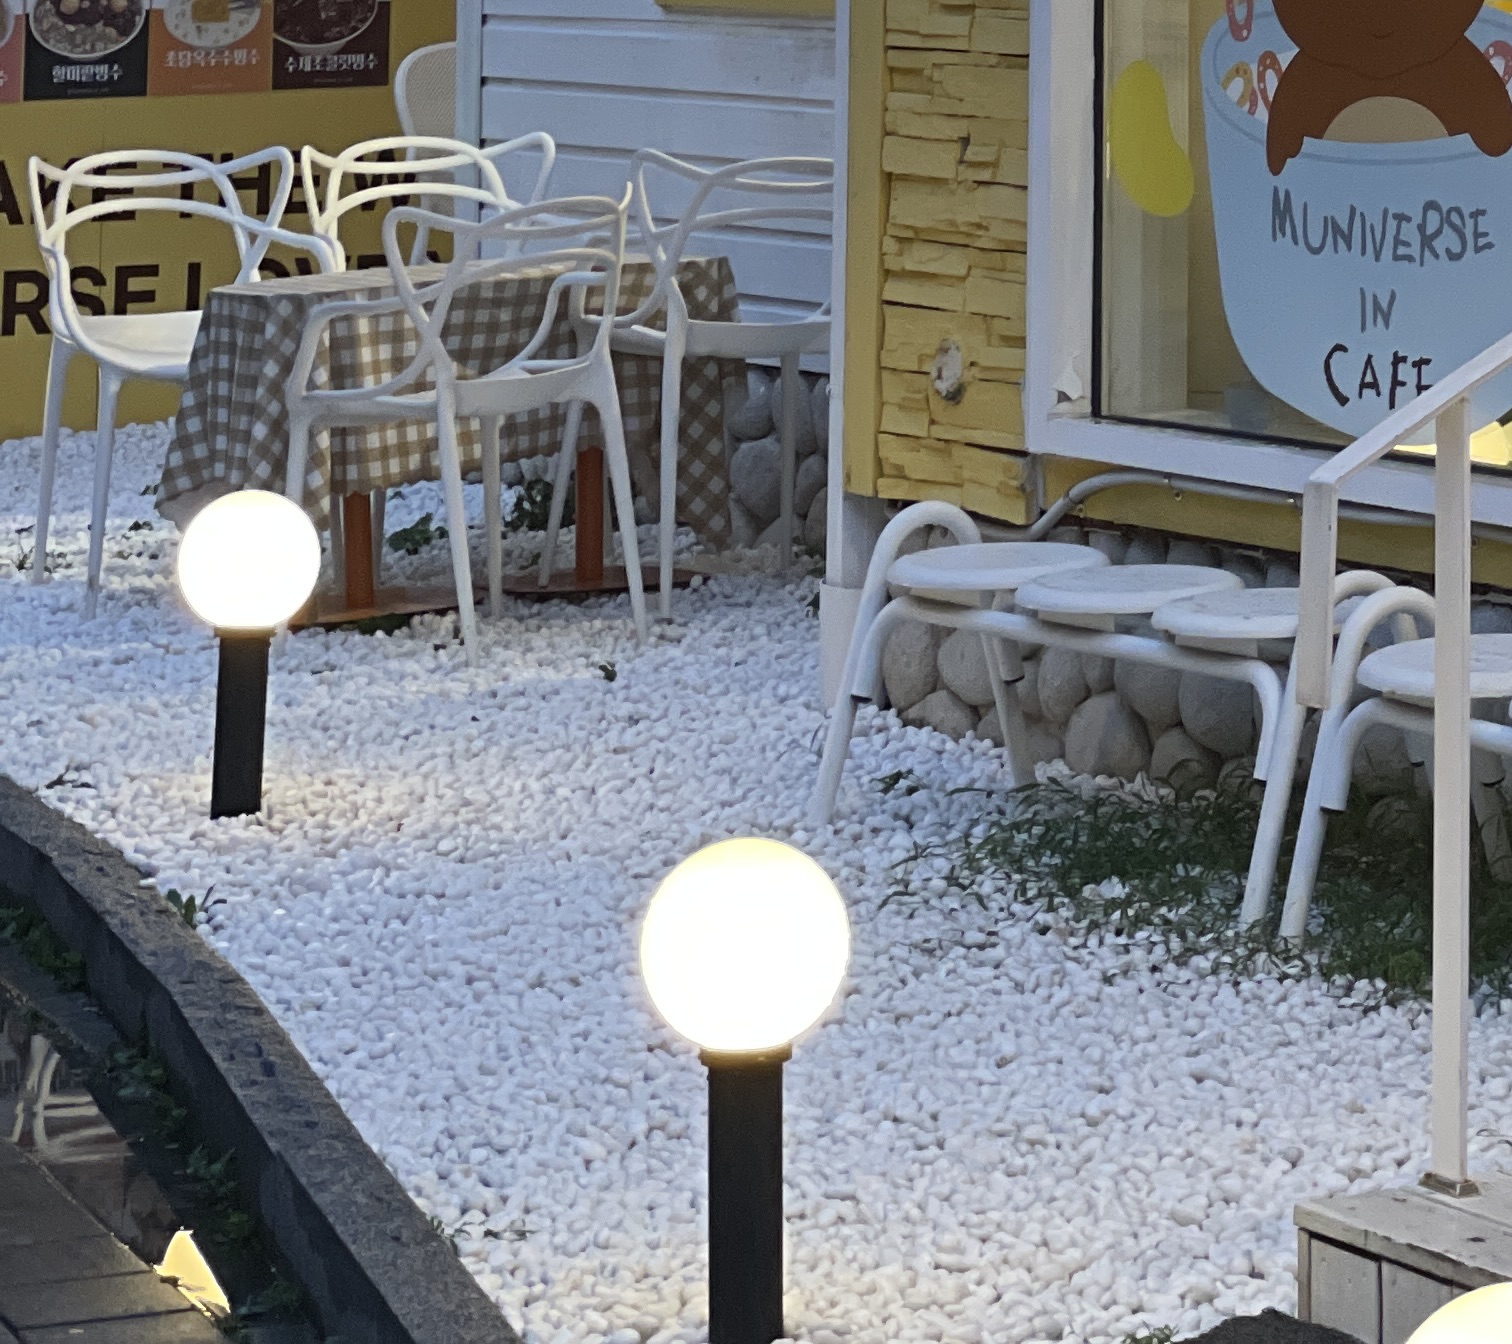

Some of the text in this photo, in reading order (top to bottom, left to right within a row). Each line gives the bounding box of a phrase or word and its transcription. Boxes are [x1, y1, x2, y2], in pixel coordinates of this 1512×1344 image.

[1271, 185, 1496, 267] MUNIVERSE
[1359, 286, 1396, 333] IN
[1324, 343, 1434, 410] CAFE
